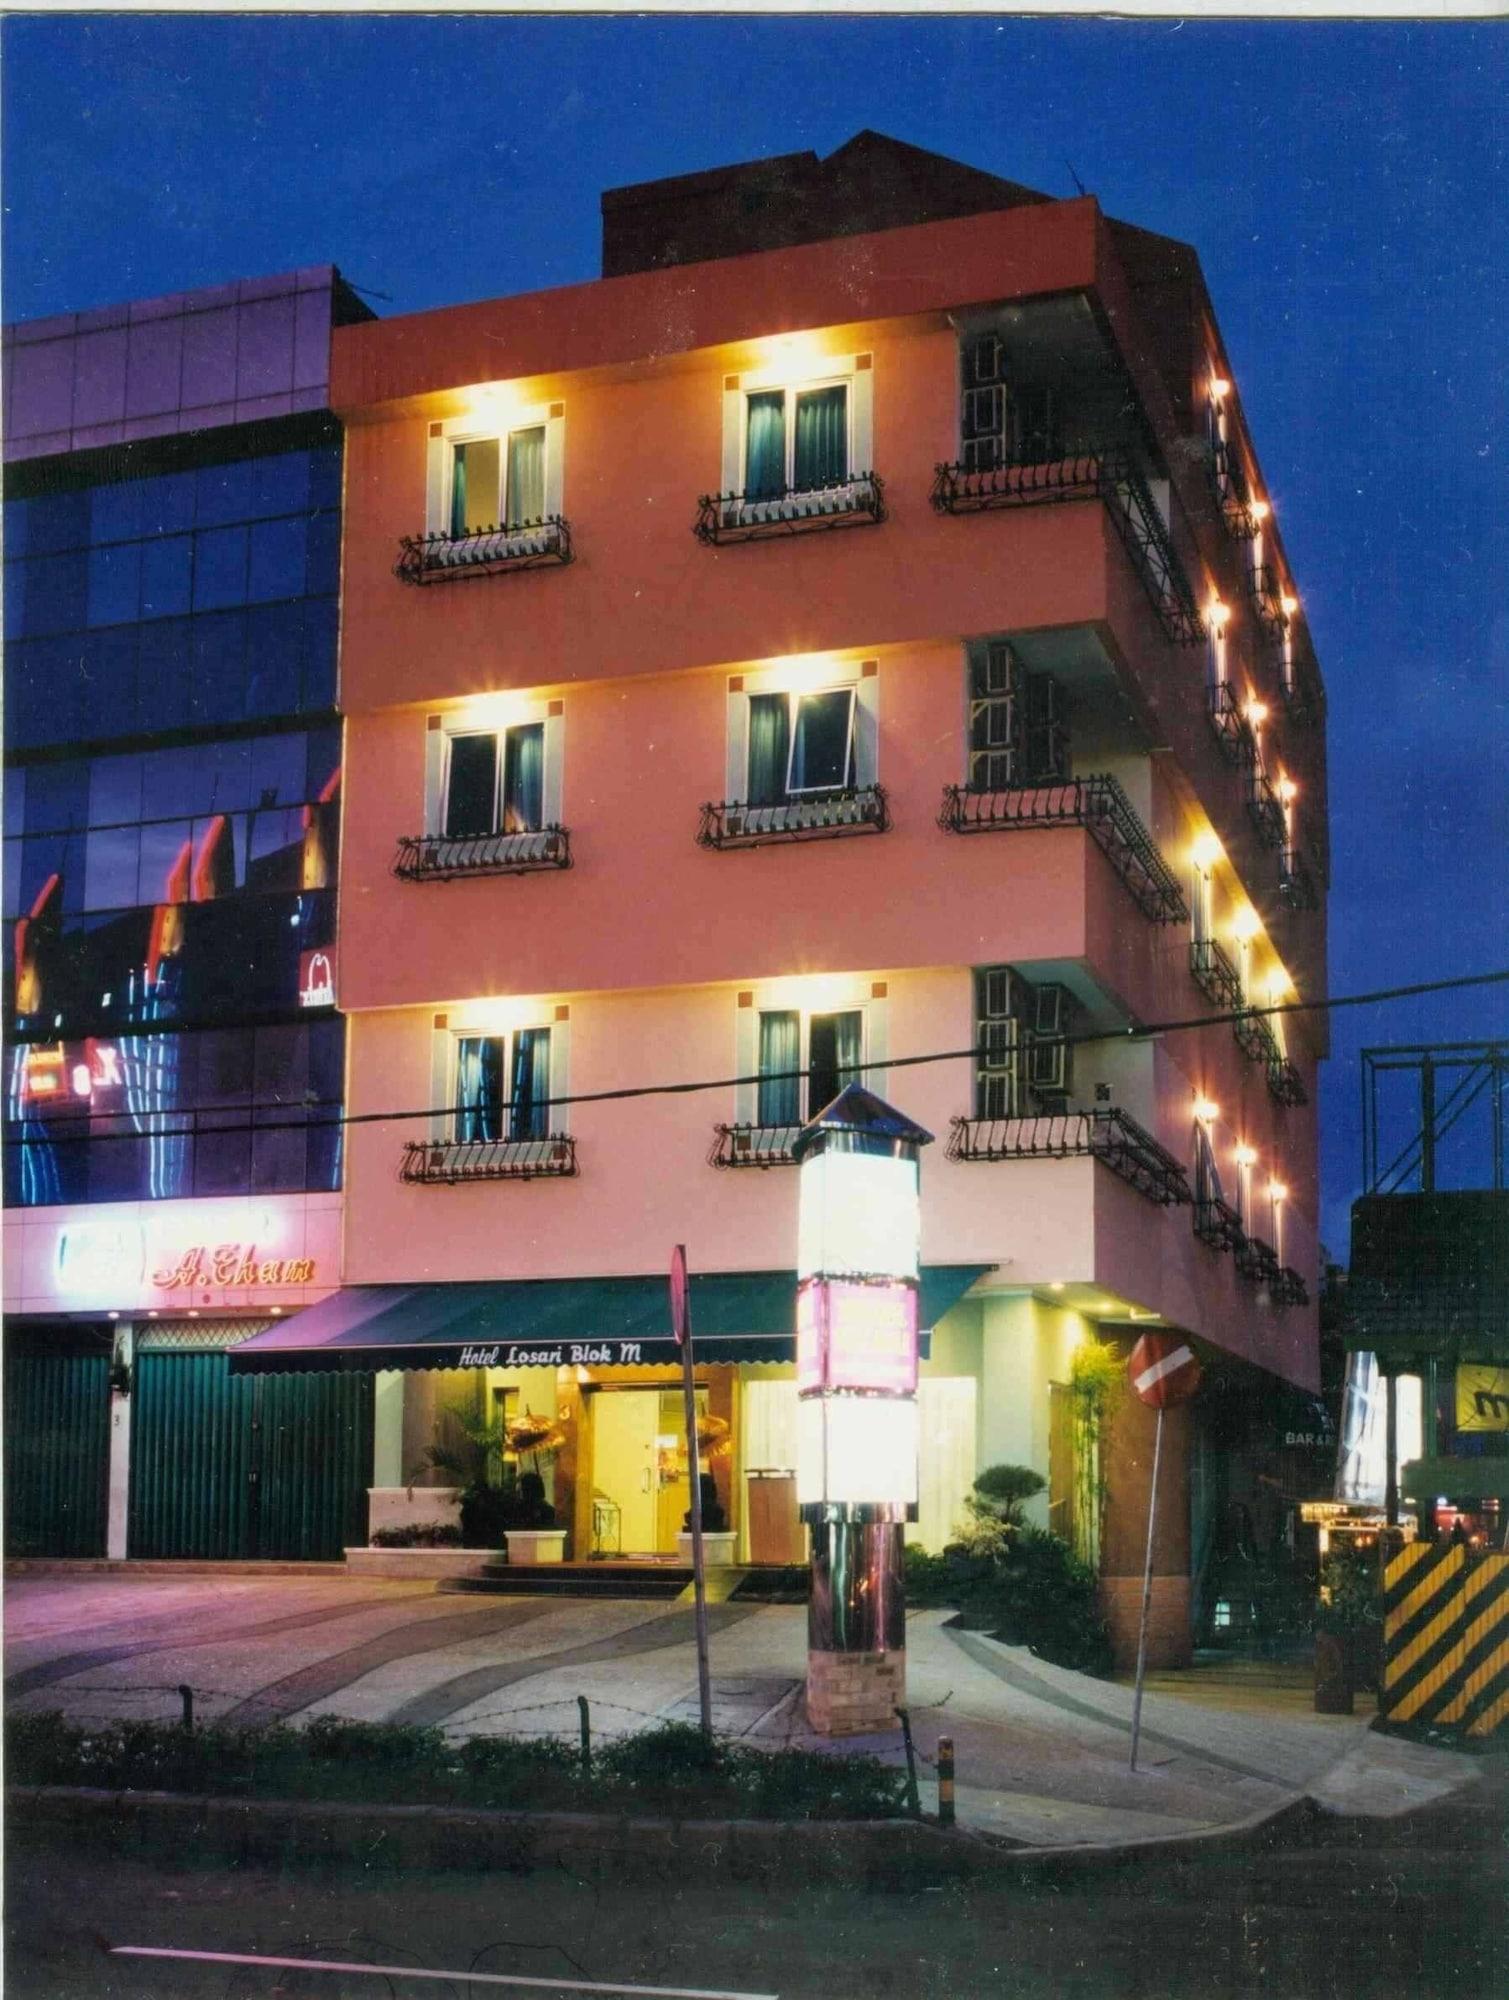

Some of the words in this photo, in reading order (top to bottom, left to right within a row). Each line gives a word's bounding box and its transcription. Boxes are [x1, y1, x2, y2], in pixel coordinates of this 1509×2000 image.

[459, 1346, 500, 1366] Hotel
[506, 1345, 562, 1364] Losari
[570, 1344, 612, 1363] Blok
[619, 1342, 641, 1361] M
[1285, 1431, 1314, 1447] BAR
